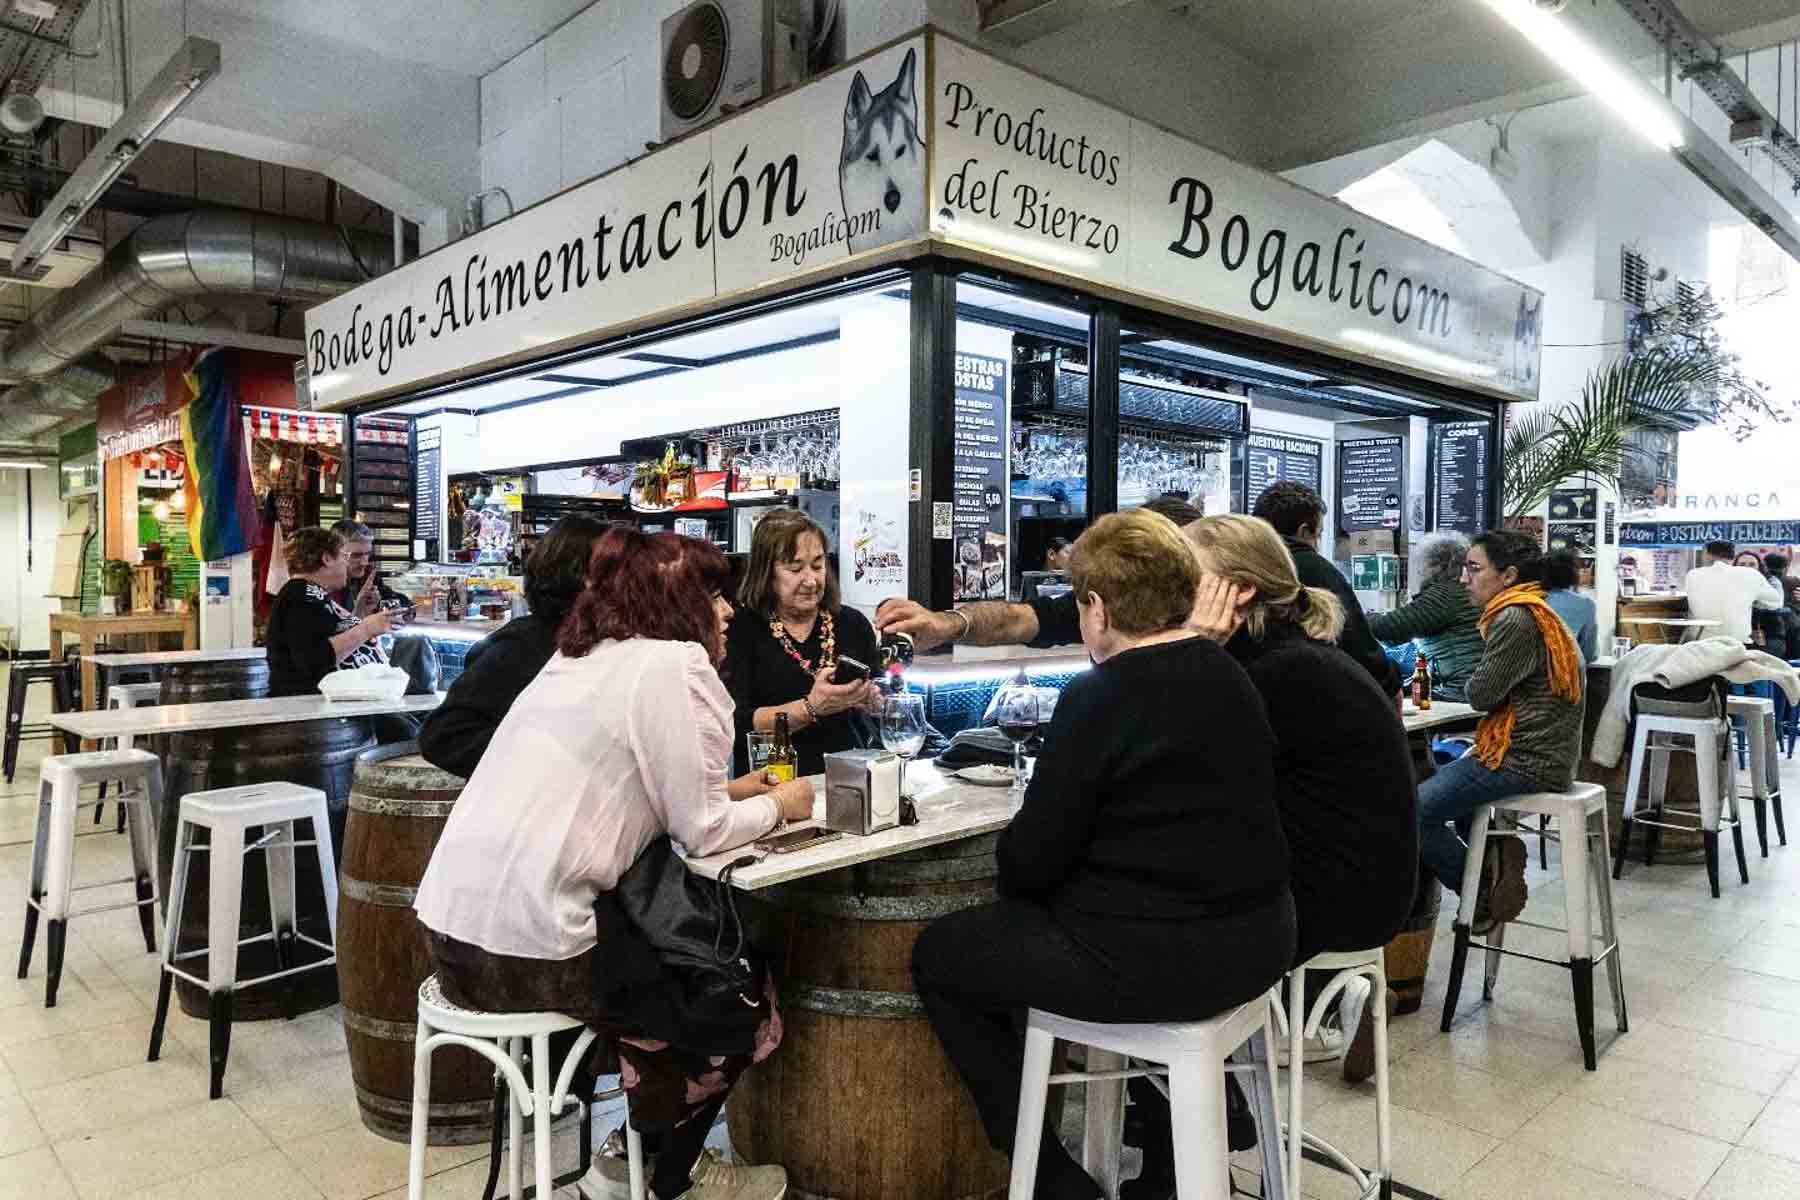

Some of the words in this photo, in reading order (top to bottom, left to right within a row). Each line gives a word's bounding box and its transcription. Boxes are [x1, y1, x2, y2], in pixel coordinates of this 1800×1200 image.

[945, 81, 1120, 186] Productos
[769, 208, 881, 265] Bogalicom
[944, 159, 1009, 219] del
[1014, 184, 1120, 255] Bierzo
[309, 145, 807, 375] Bodega-Alimentación
[1168, 176, 1452, 339] Bogalicom
[1670, 524, 1722, 541] OSTRAS
